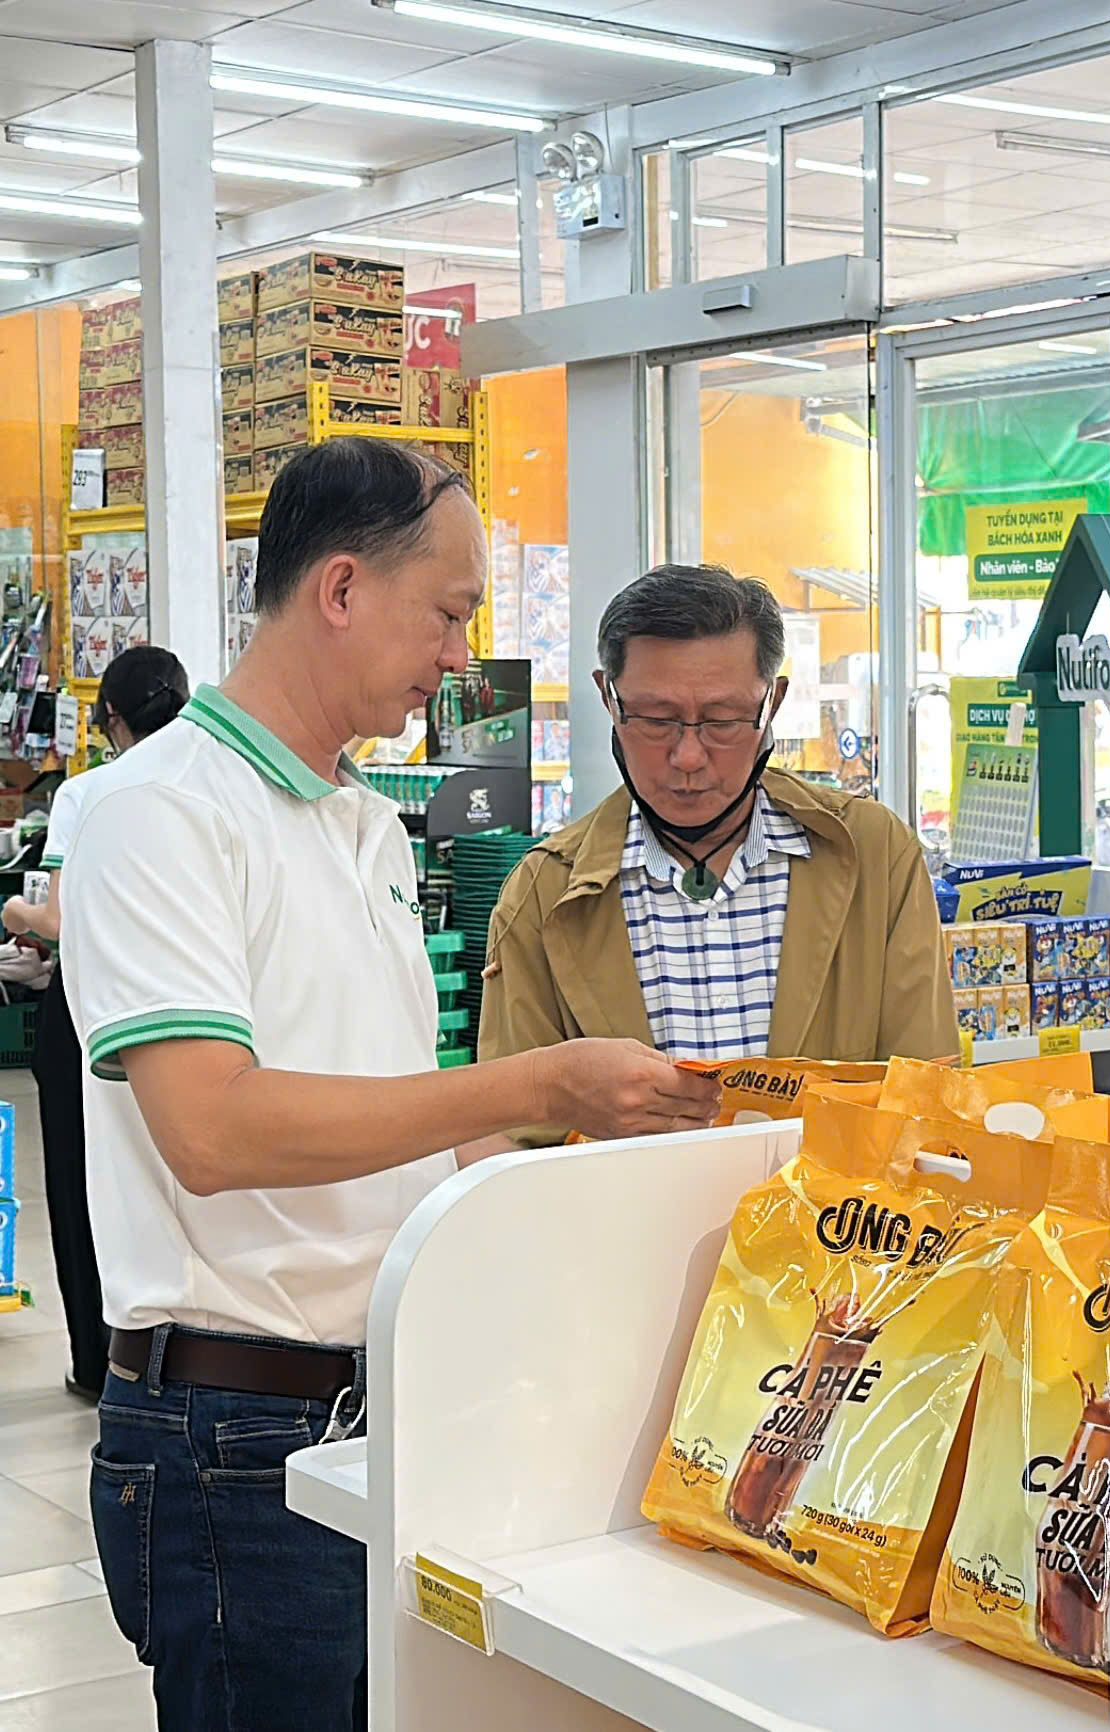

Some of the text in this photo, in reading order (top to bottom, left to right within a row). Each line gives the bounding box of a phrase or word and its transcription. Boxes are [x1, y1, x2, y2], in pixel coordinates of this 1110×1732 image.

[1035, 530, 1062, 543] XANH
[758, 1358, 882, 1403] CÀ PHÊ
[672, 1446, 688, 1461] 00%
[1022, 1453, 1087, 1501] CÀ
[801, 1504, 817, 1520] 720
[861, 1527, 875, 1541] 24
[1042, 1503, 1102, 1550] SỮA
